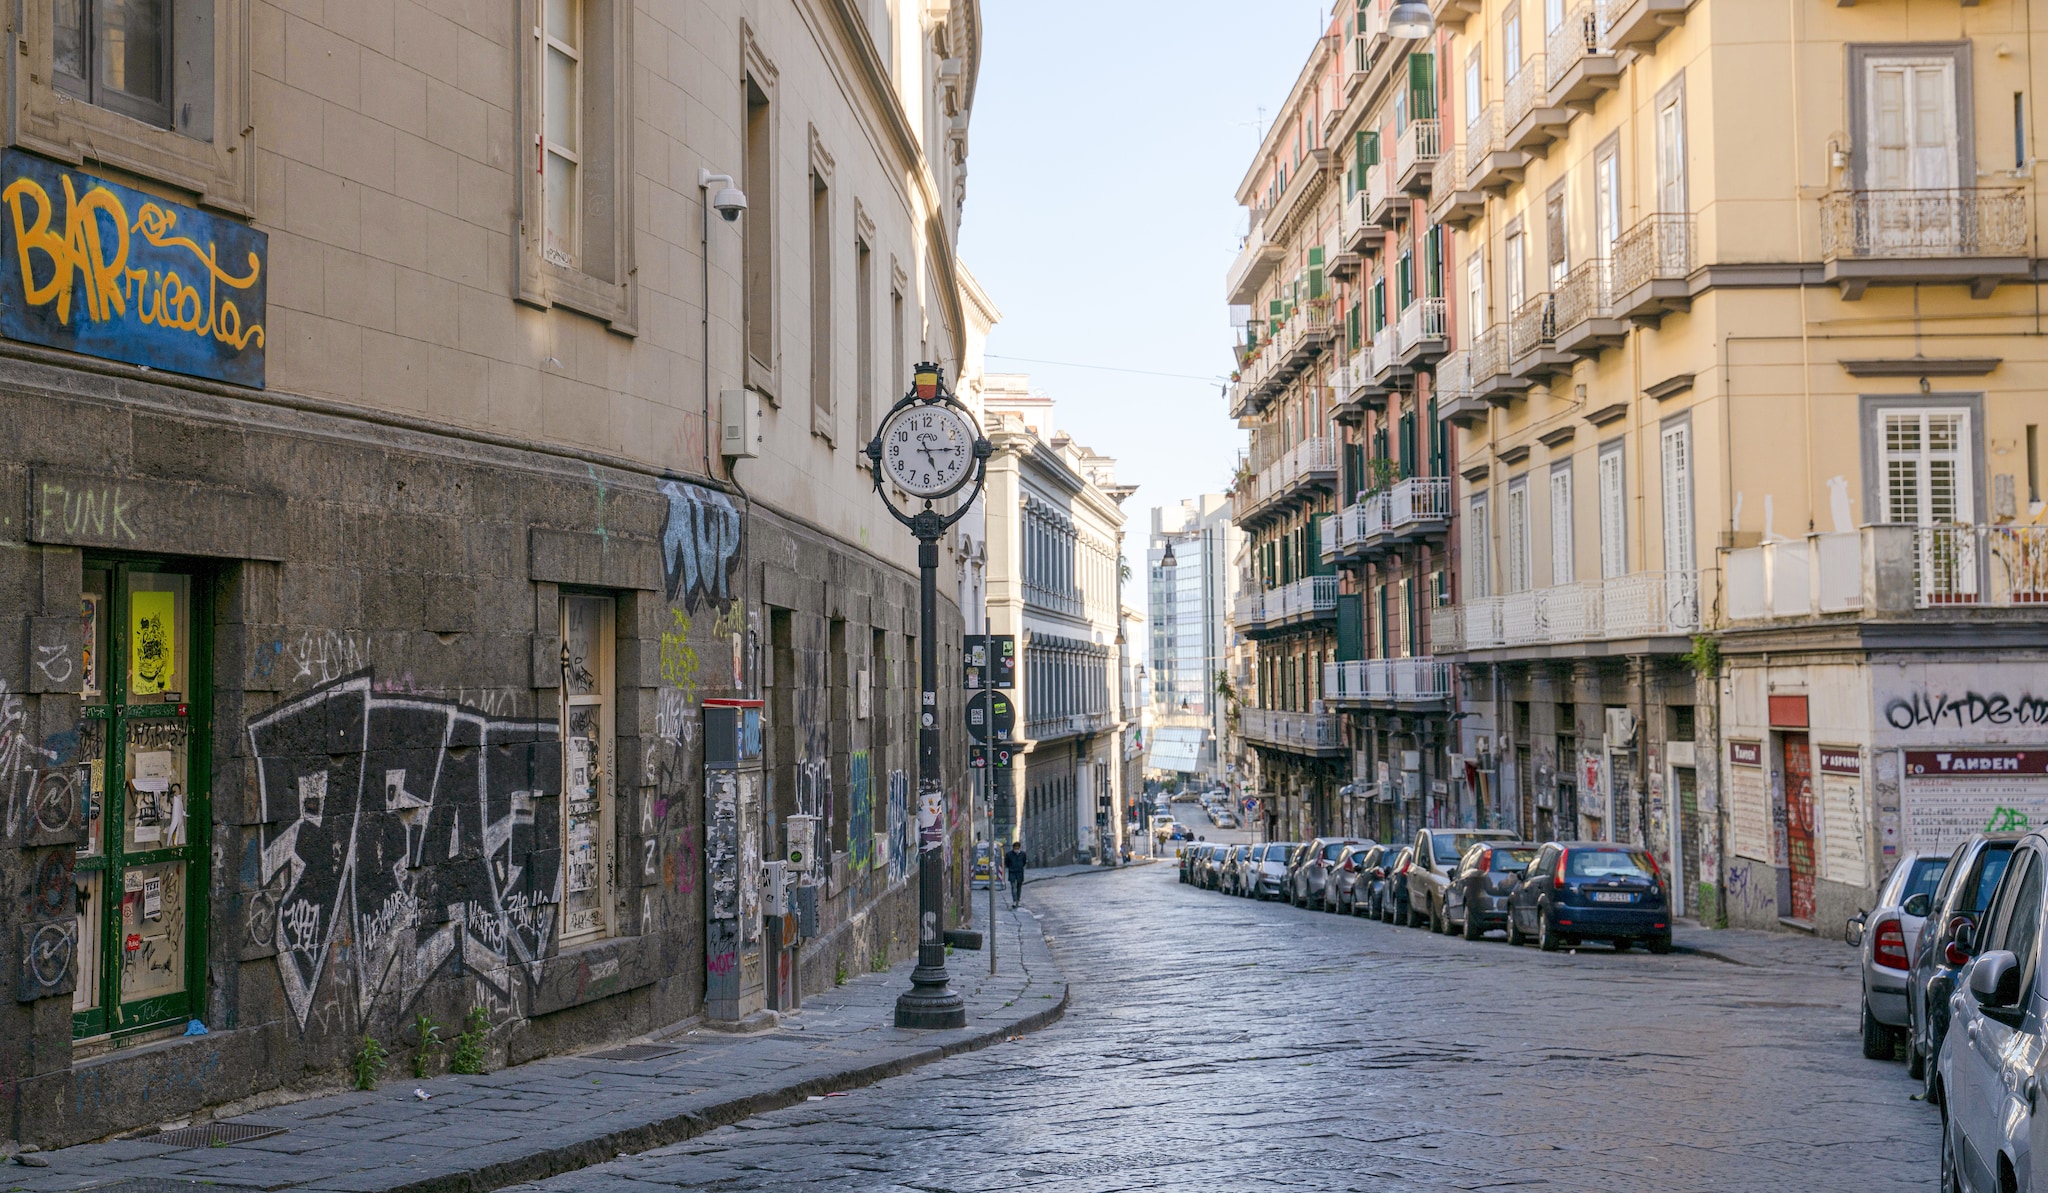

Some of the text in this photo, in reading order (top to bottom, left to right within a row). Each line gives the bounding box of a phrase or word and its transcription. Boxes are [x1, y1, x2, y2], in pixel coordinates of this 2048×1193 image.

[910, 420, 918, 432] 11
[922, 416, 933, 428] 12
[940, 420, 945, 432] 1
[898, 431, 908, 442] 10
[948, 429, 956, 441] 2
[893, 445, 900, 456] 9
[954, 445, 961, 456] 3
[898, 459, 905, 471] 8
[948, 459, 955, 471] 4
[909, 469, 917, 481] 7
[923, 473, 930, 485] 6
[937, 470, 944, 481] 5
[40, 482, 136, 540] FUNK
[1830, 755, 1860, 768] ASPORTO
